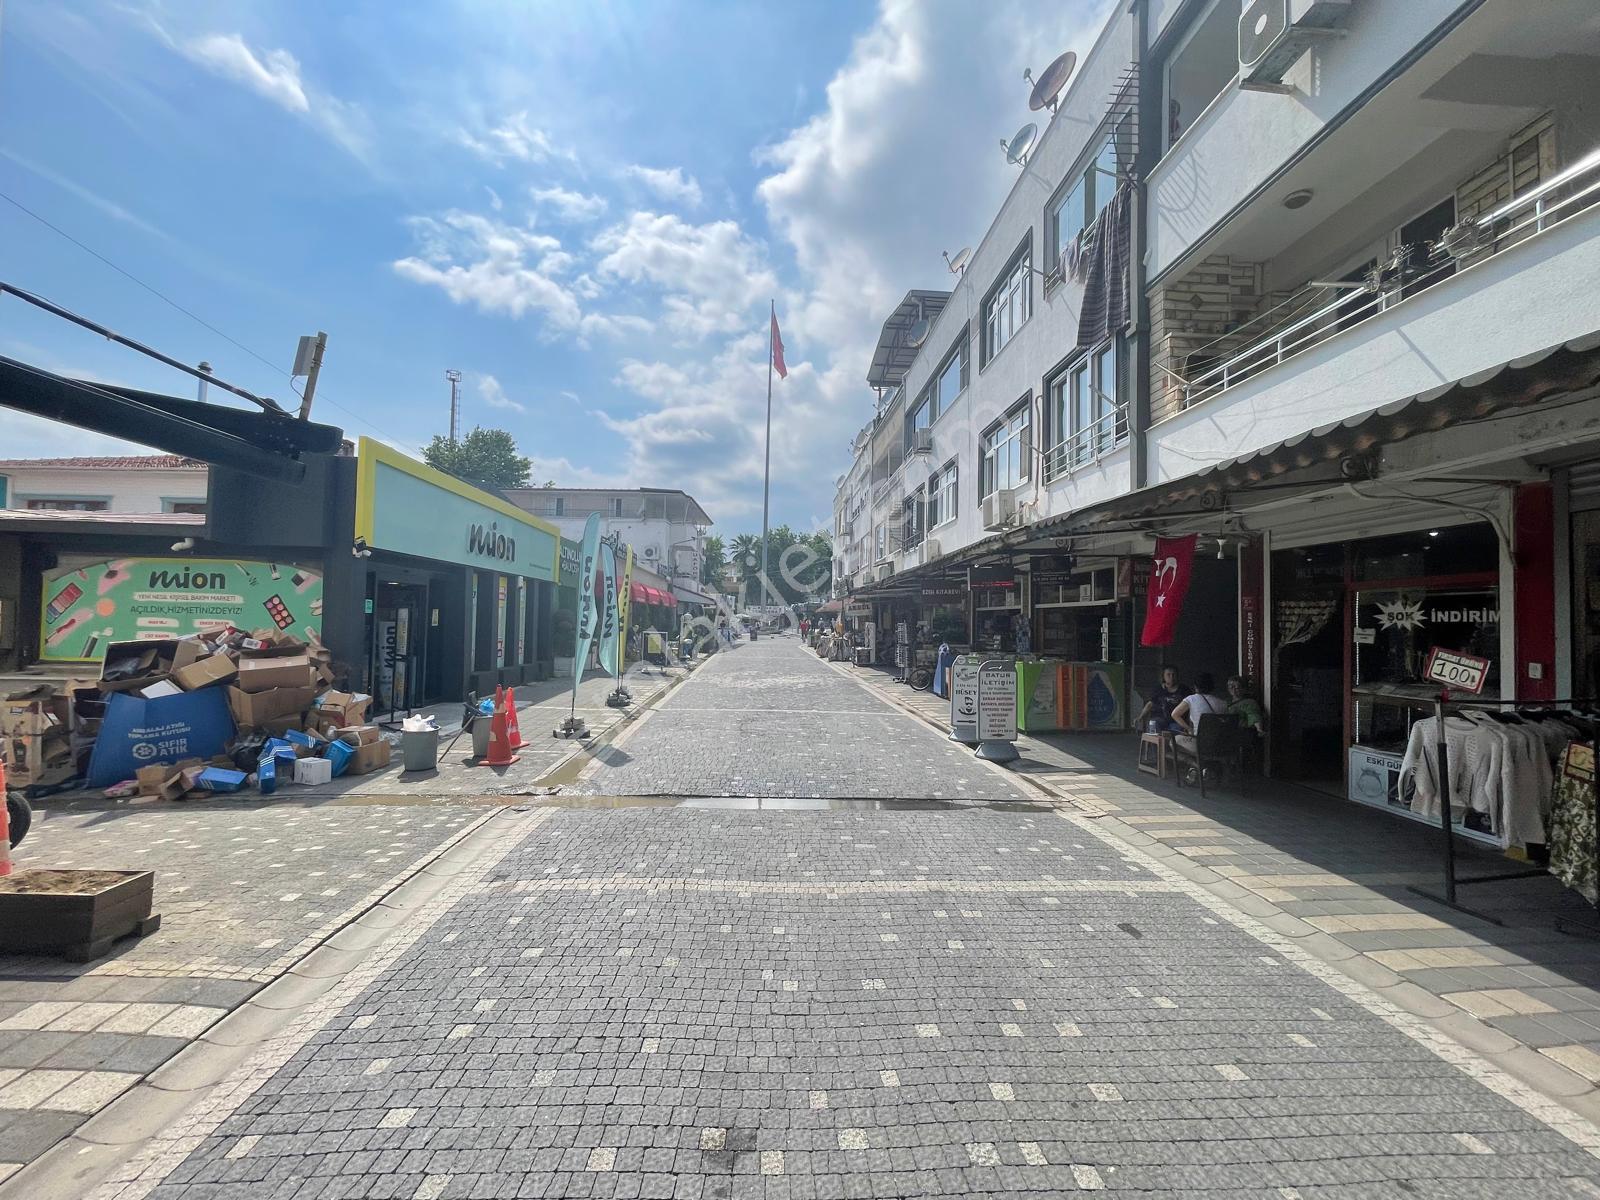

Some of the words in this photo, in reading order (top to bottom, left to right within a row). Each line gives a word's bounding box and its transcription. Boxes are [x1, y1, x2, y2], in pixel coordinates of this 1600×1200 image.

[468, 521, 516, 562] mion
[149, 566, 226, 589] mion
[158, 738, 187, 749] SIFIR
[159, 745, 188, 756] ATIK
